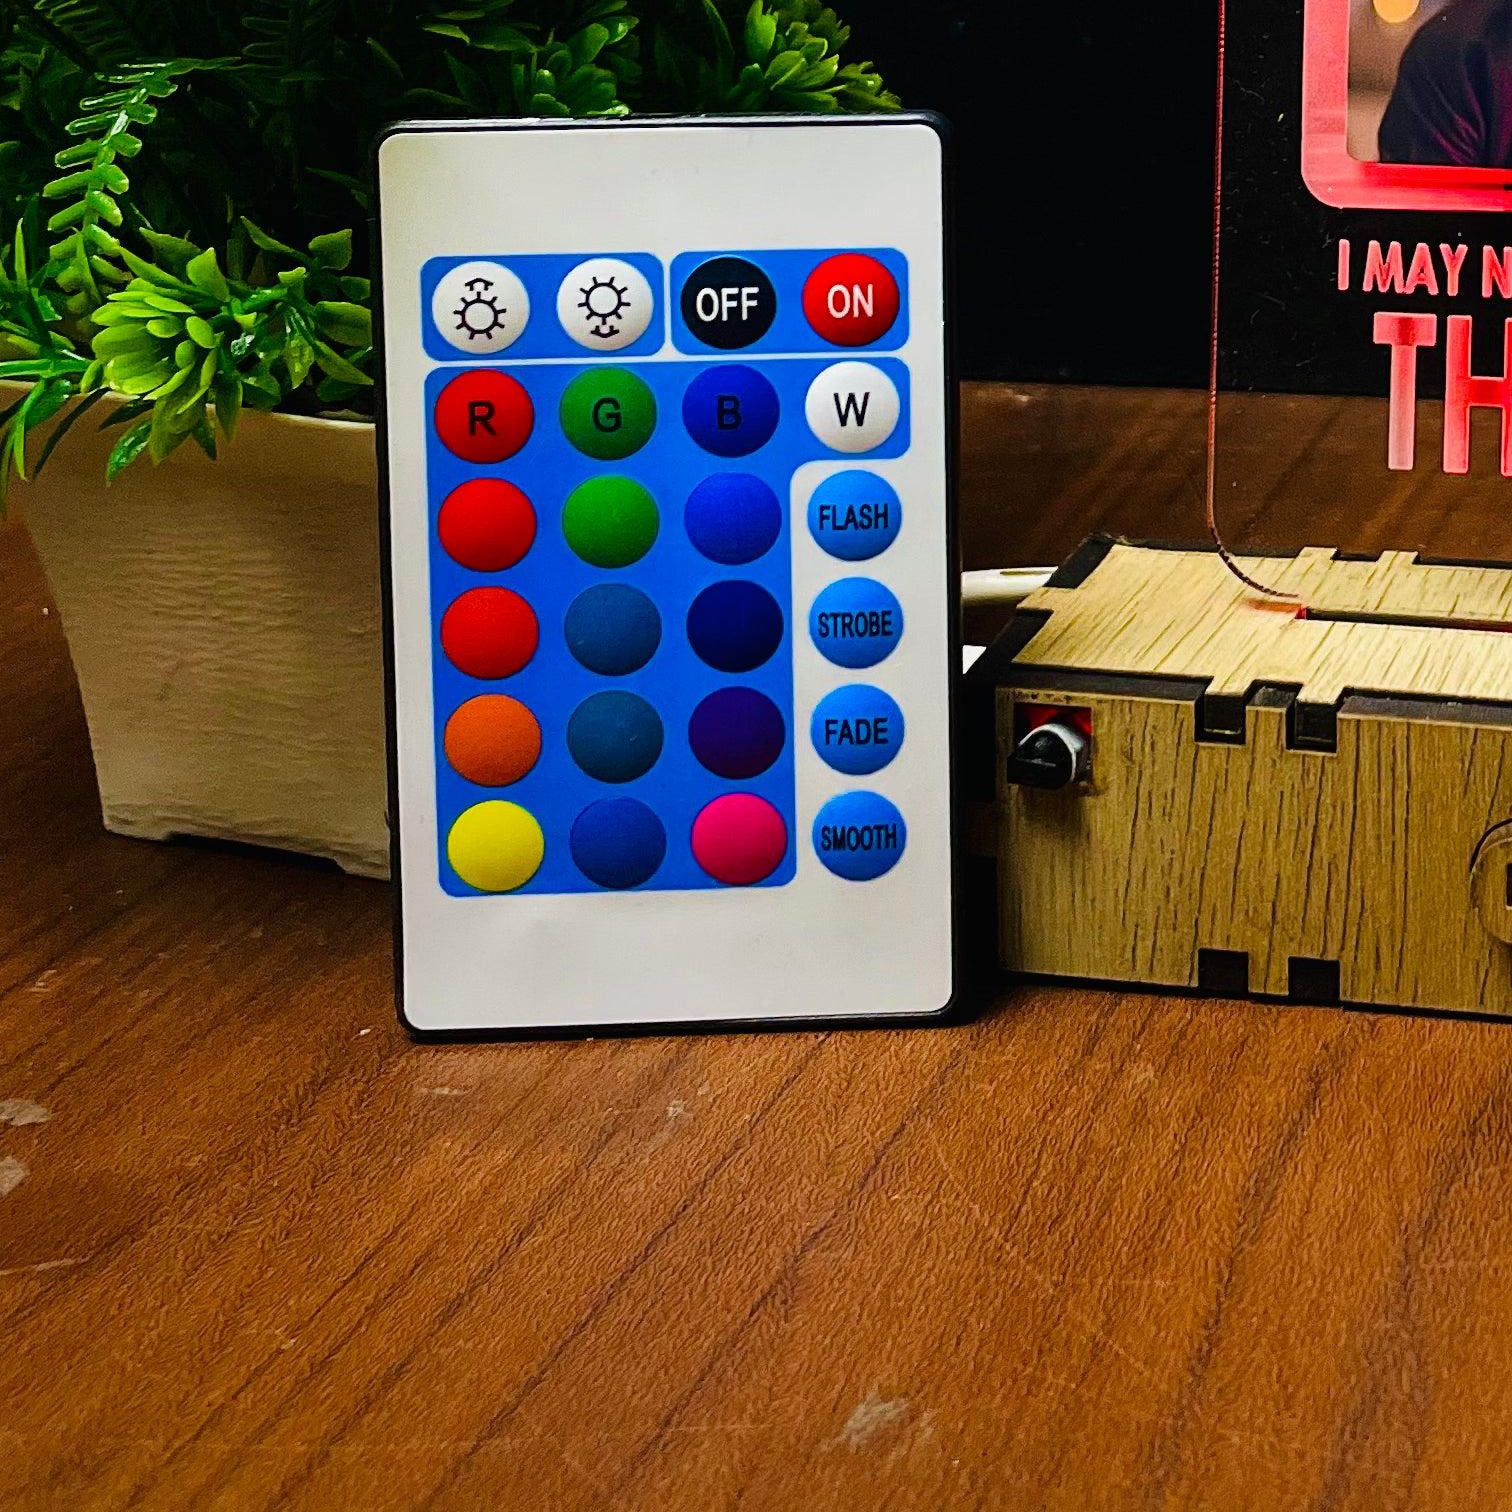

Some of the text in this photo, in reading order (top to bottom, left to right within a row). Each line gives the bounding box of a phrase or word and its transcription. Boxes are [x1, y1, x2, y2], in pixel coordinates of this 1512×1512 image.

[1338, 239, 1350, 292] I
[1362, 241, 1468, 297] MAY
[696, 286, 760, 322] OFF
[826, 284, 875, 319] ON
[467, 400, 496, 437] R
[591, 397, 622, 433] G
[716, 395, 742, 431] B
[833, 392, 870, 428] W
[818, 504, 889, 532] FLASH
[817, 611, 893, 638] STROBE
[824, 718, 889, 746] FADE
[820, 824, 898, 852] SMOOTH
